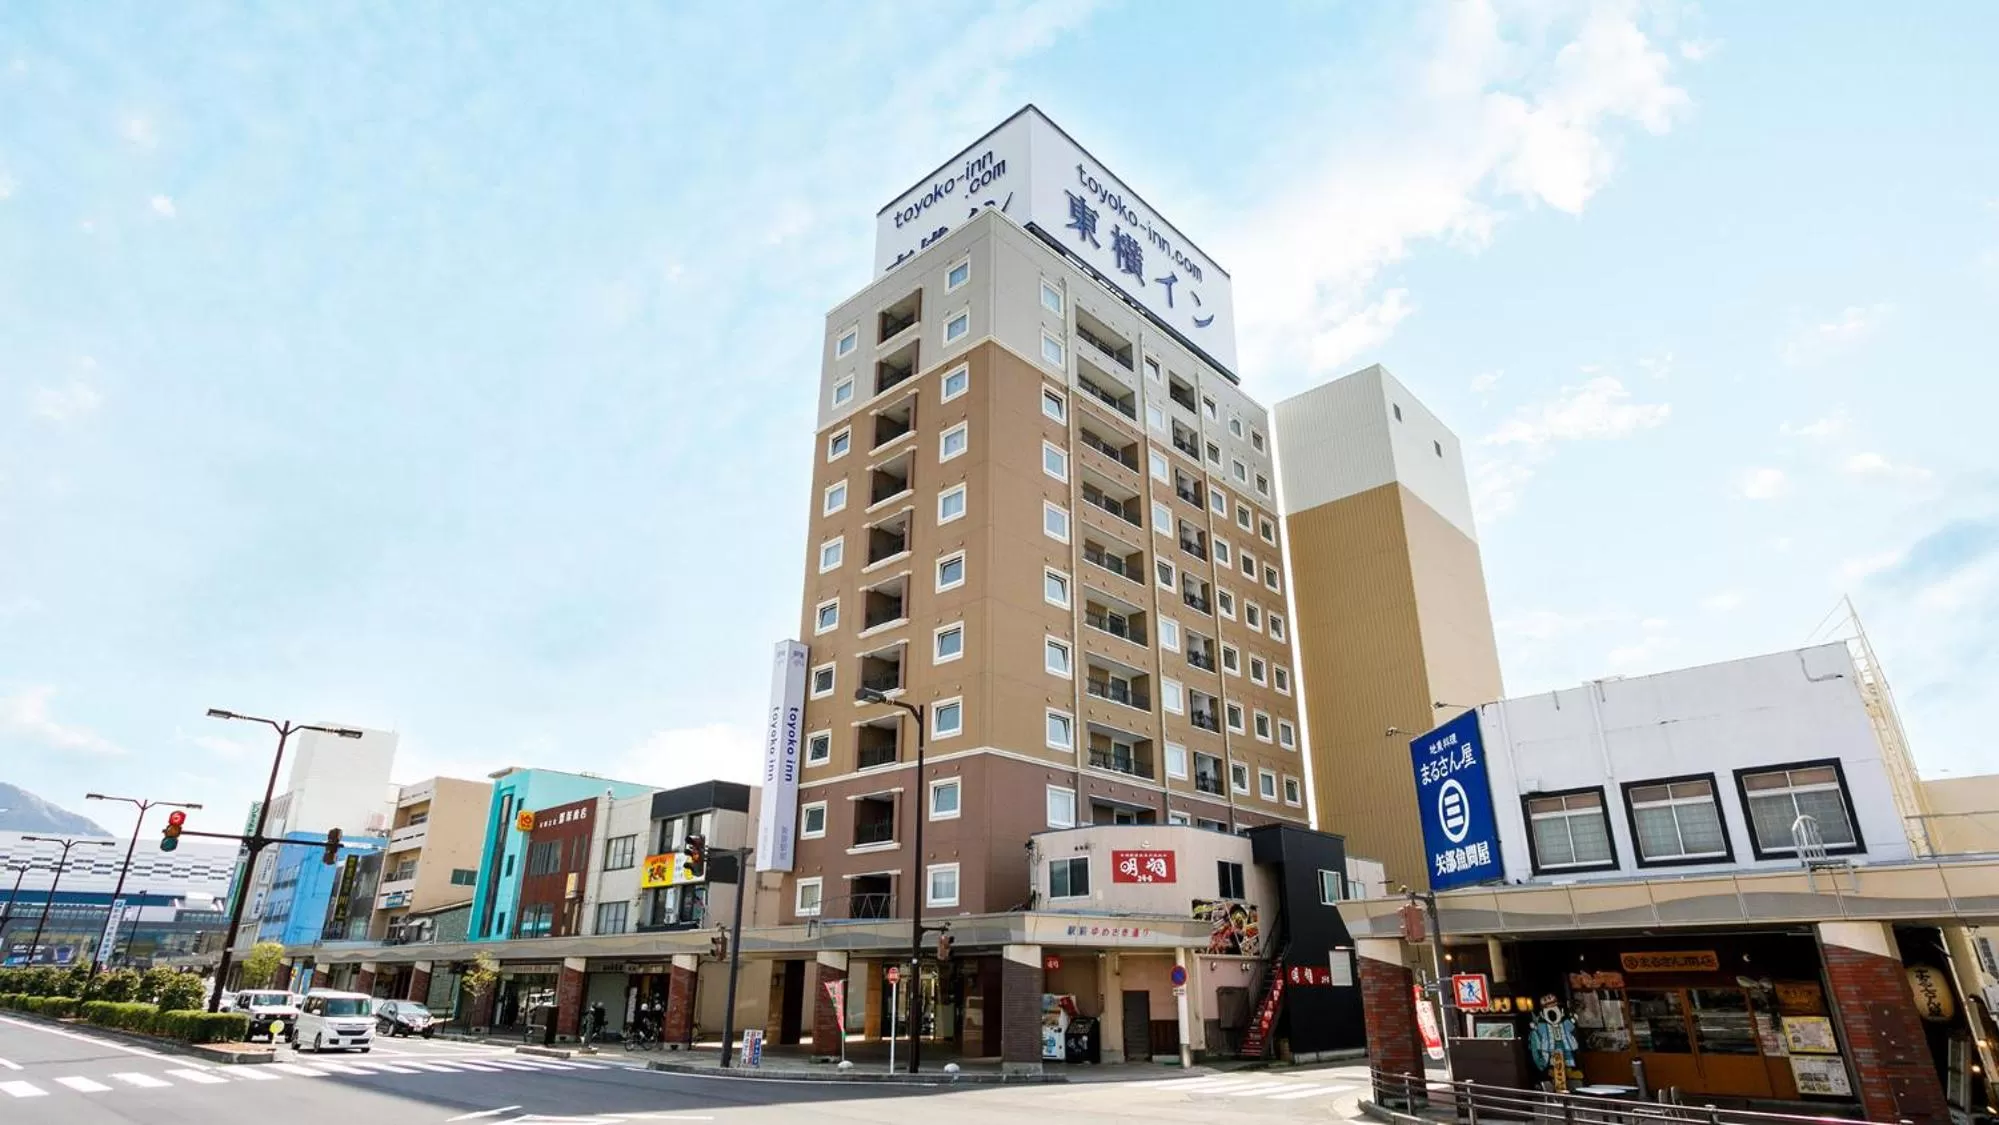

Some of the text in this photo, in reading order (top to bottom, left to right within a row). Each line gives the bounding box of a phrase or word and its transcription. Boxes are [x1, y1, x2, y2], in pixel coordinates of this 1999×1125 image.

[894, 151, 993, 228] toyoko-inn
[965, 160, 1006, 199] .com
[1064, 189, 1214, 328] 東横イン
[1076, 163, 1203, 283] toyoko-inn.com
[767, 706, 780, 782] toyoko inn
[784, 707, 799, 782] toyoko inn
[1420, 742, 1476, 786] まるさん屋
[1435, 840, 1491, 876] 矢部魚問屋
